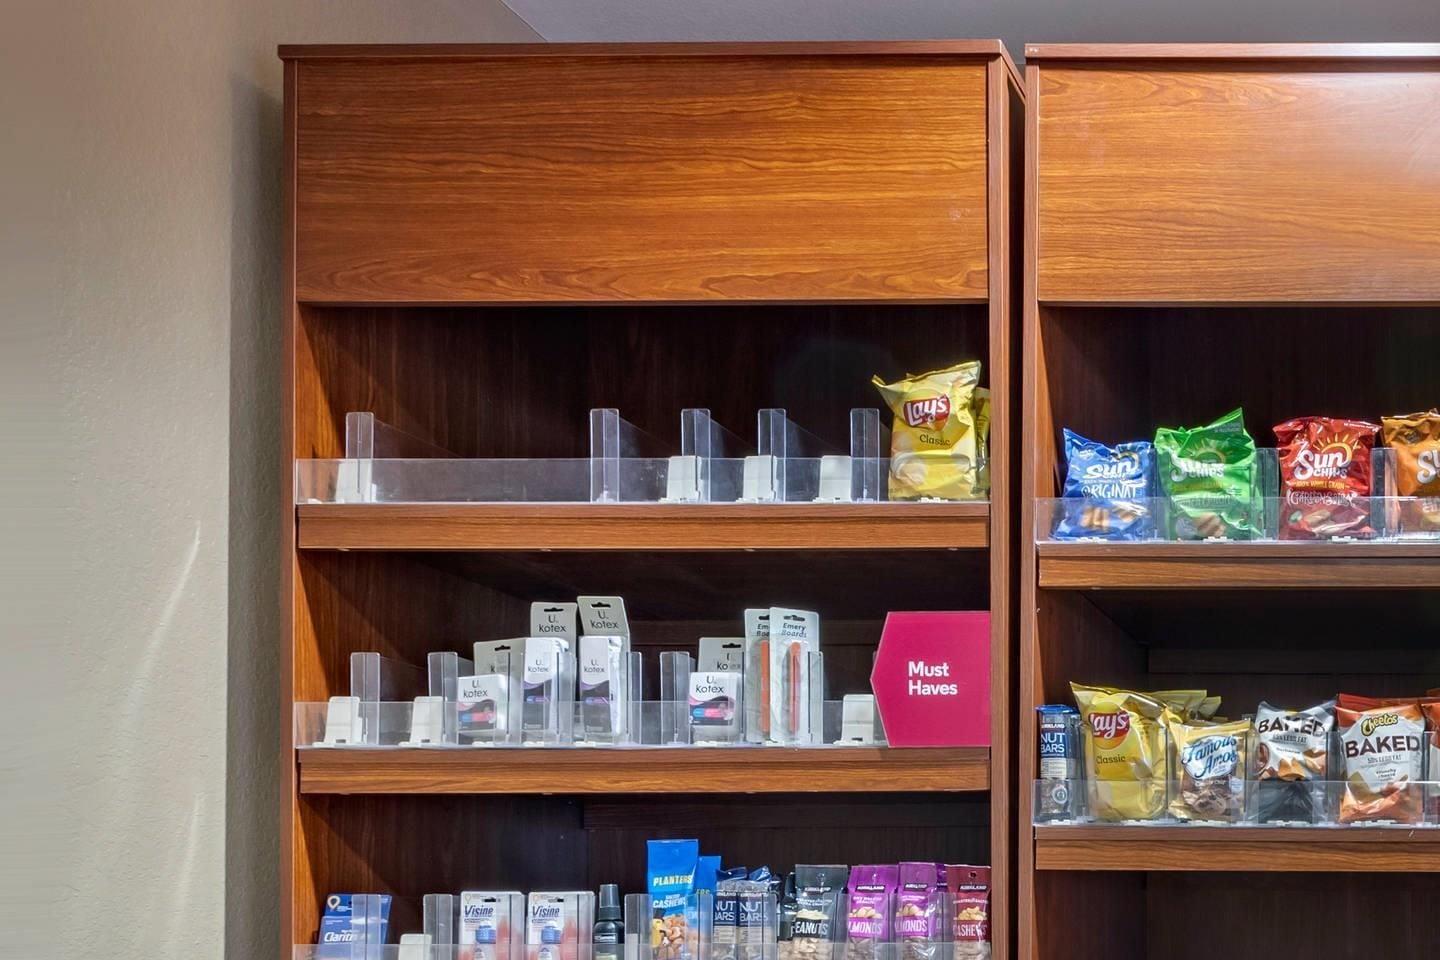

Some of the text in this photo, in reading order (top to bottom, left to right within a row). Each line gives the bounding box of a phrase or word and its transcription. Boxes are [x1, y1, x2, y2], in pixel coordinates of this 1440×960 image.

[907, 395, 949, 426] Lay's
[1294, 449, 1352, 480] Sun
[1313, 467, 1348, 479] CHIPS
[538, 623, 567, 633] kotex
[590, 619, 619, 630] kotex
[783, 622, 807, 634] Emery
[781, 630, 807, 639] Boards
[527, 665, 549, 673] kotex
[908, 660, 950, 677] Must
[463, 687, 488, 698] kotex
[695, 685, 724, 694] kotex
[908, 679, 958, 696] Haves
[1361, 713, 1398, 737] Cheetos
[1041, 732, 1065, 744] NUT
[1181, 735, 1238, 765] Famous
[1345, 736, 1420, 758] BAKED
[1096, 754, 1126, 765] Classic
[653, 874, 693, 887] PLANTERS
[464, 904, 494, 918] Visine
[532, 904, 560, 918] Visine
